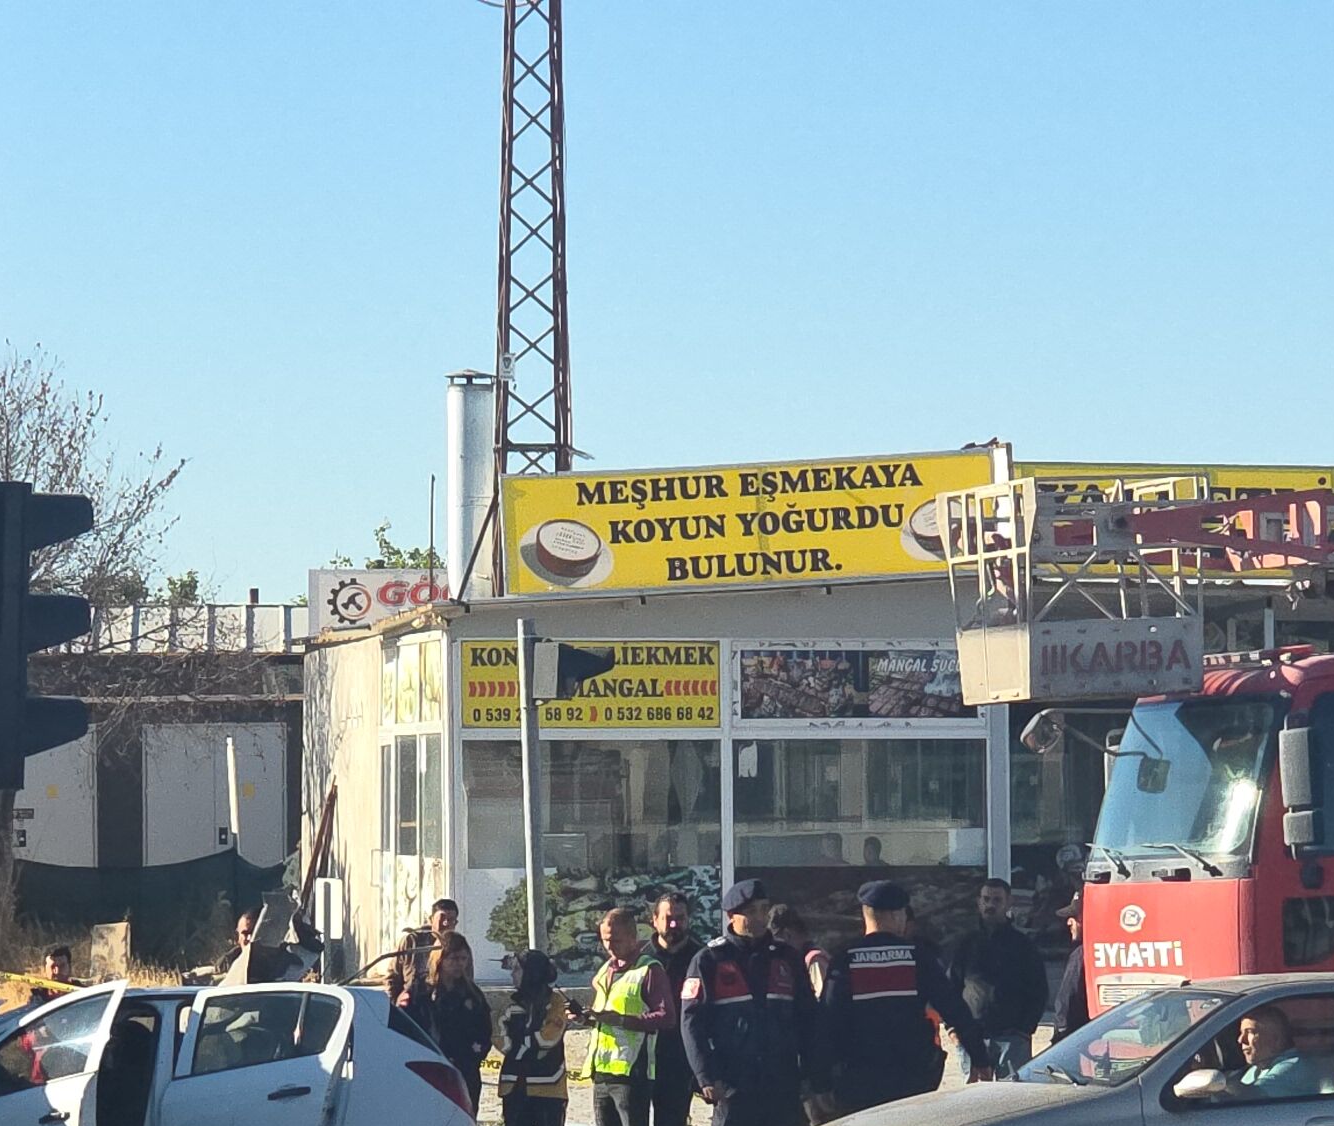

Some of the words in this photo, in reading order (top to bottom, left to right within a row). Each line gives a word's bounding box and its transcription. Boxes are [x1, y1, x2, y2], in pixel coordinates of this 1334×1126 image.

[576, 472, 728, 511] MEŞHUR
[738, 463, 923, 502] EŞMEKAYA
[608, 514, 726, 545] KOYUN
[736, 503, 905, 537] YOĞURDU
[666, 547, 843, 582] BULUNUR.
[876, 658, 927, 672] MANGAL
[473, 708, 481, 722] 0
[486, 708, 511, 722] 539
[566, 707, 584, 721] 92
[604, 706, 613, 721] 0
[617, 706, 643, 721] 532
[647, 706, 672, 721] 686
[676, 706, 693, 721] 68
[697, 706, 714, 721] 42
[852, 949, 913, 962] JANDARMA
